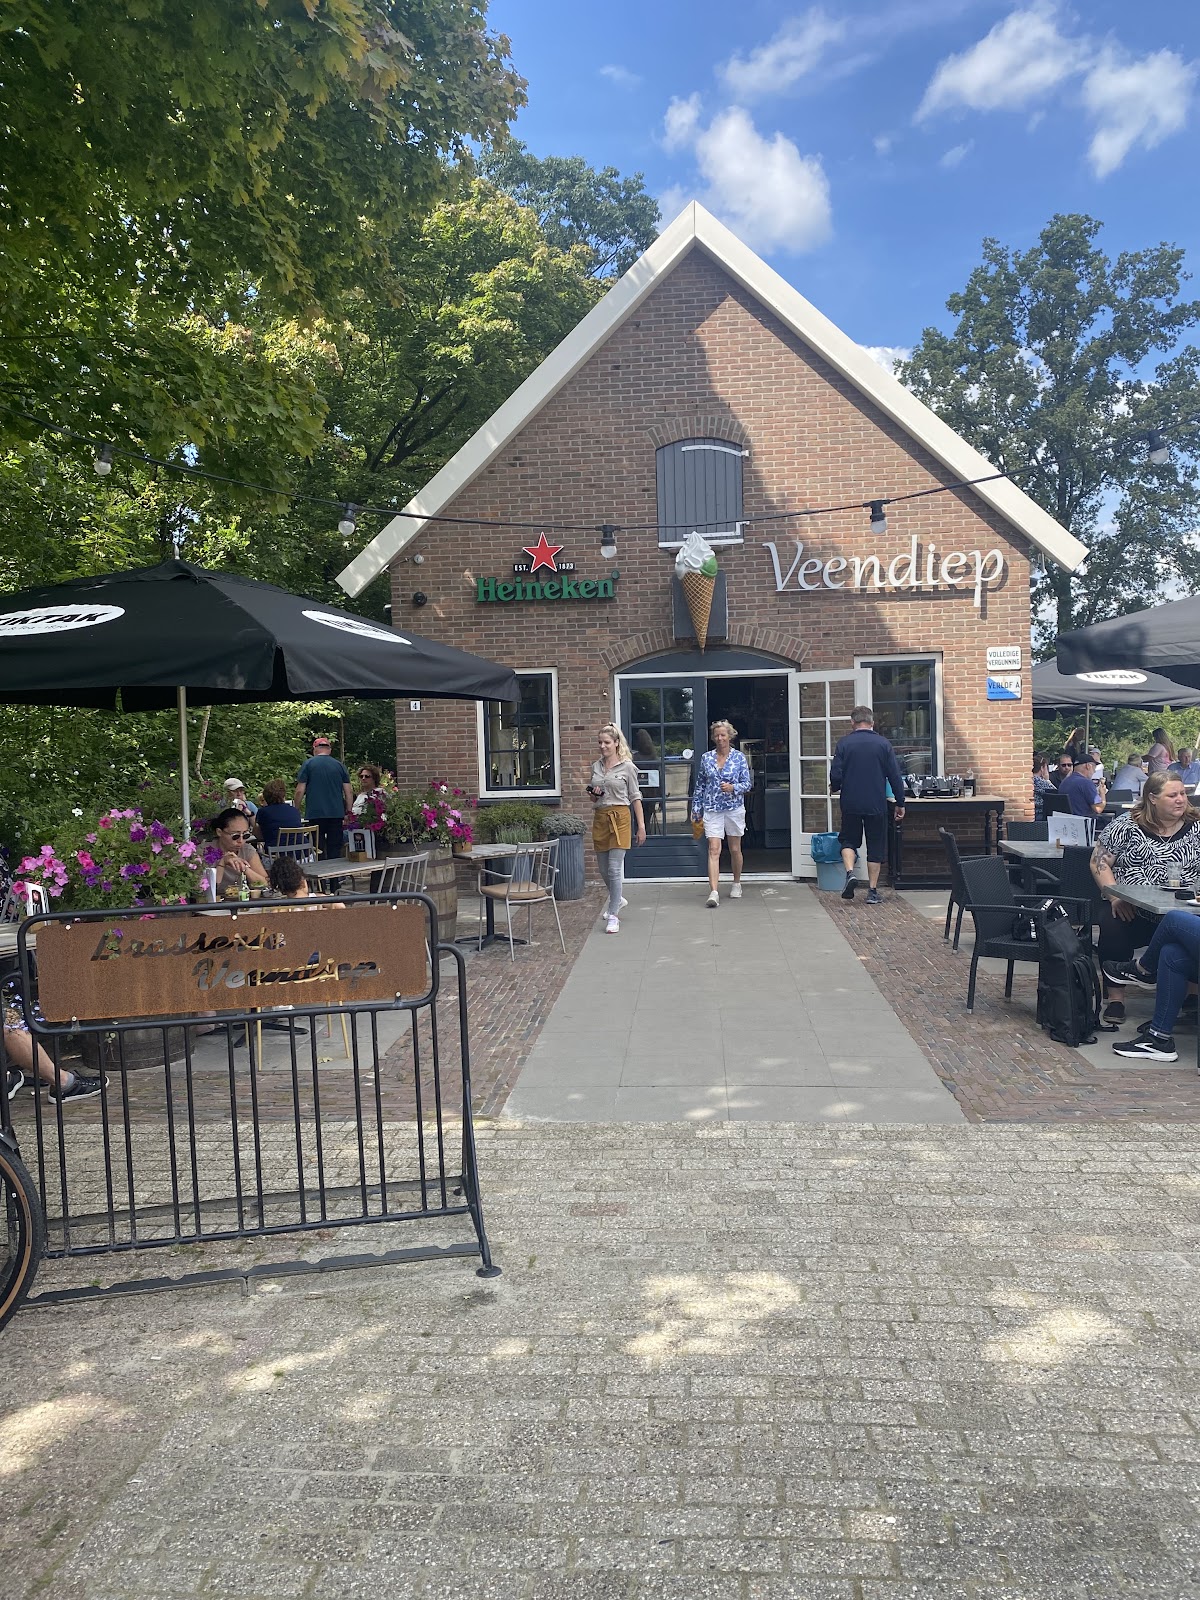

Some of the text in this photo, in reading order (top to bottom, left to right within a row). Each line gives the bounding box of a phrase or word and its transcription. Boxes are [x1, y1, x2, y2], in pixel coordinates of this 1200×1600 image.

[763, 534, 1003, 607] Veendiep
[477, 575, 616, 601] Heineken
[987, 658, 1020, 666] VERGUNNING
[988, 650, 1020, 658] VOLLEDIGE
[987, 681, 1021, 690] VERLOF A
[90, 926, 287, 962] Brasserie
